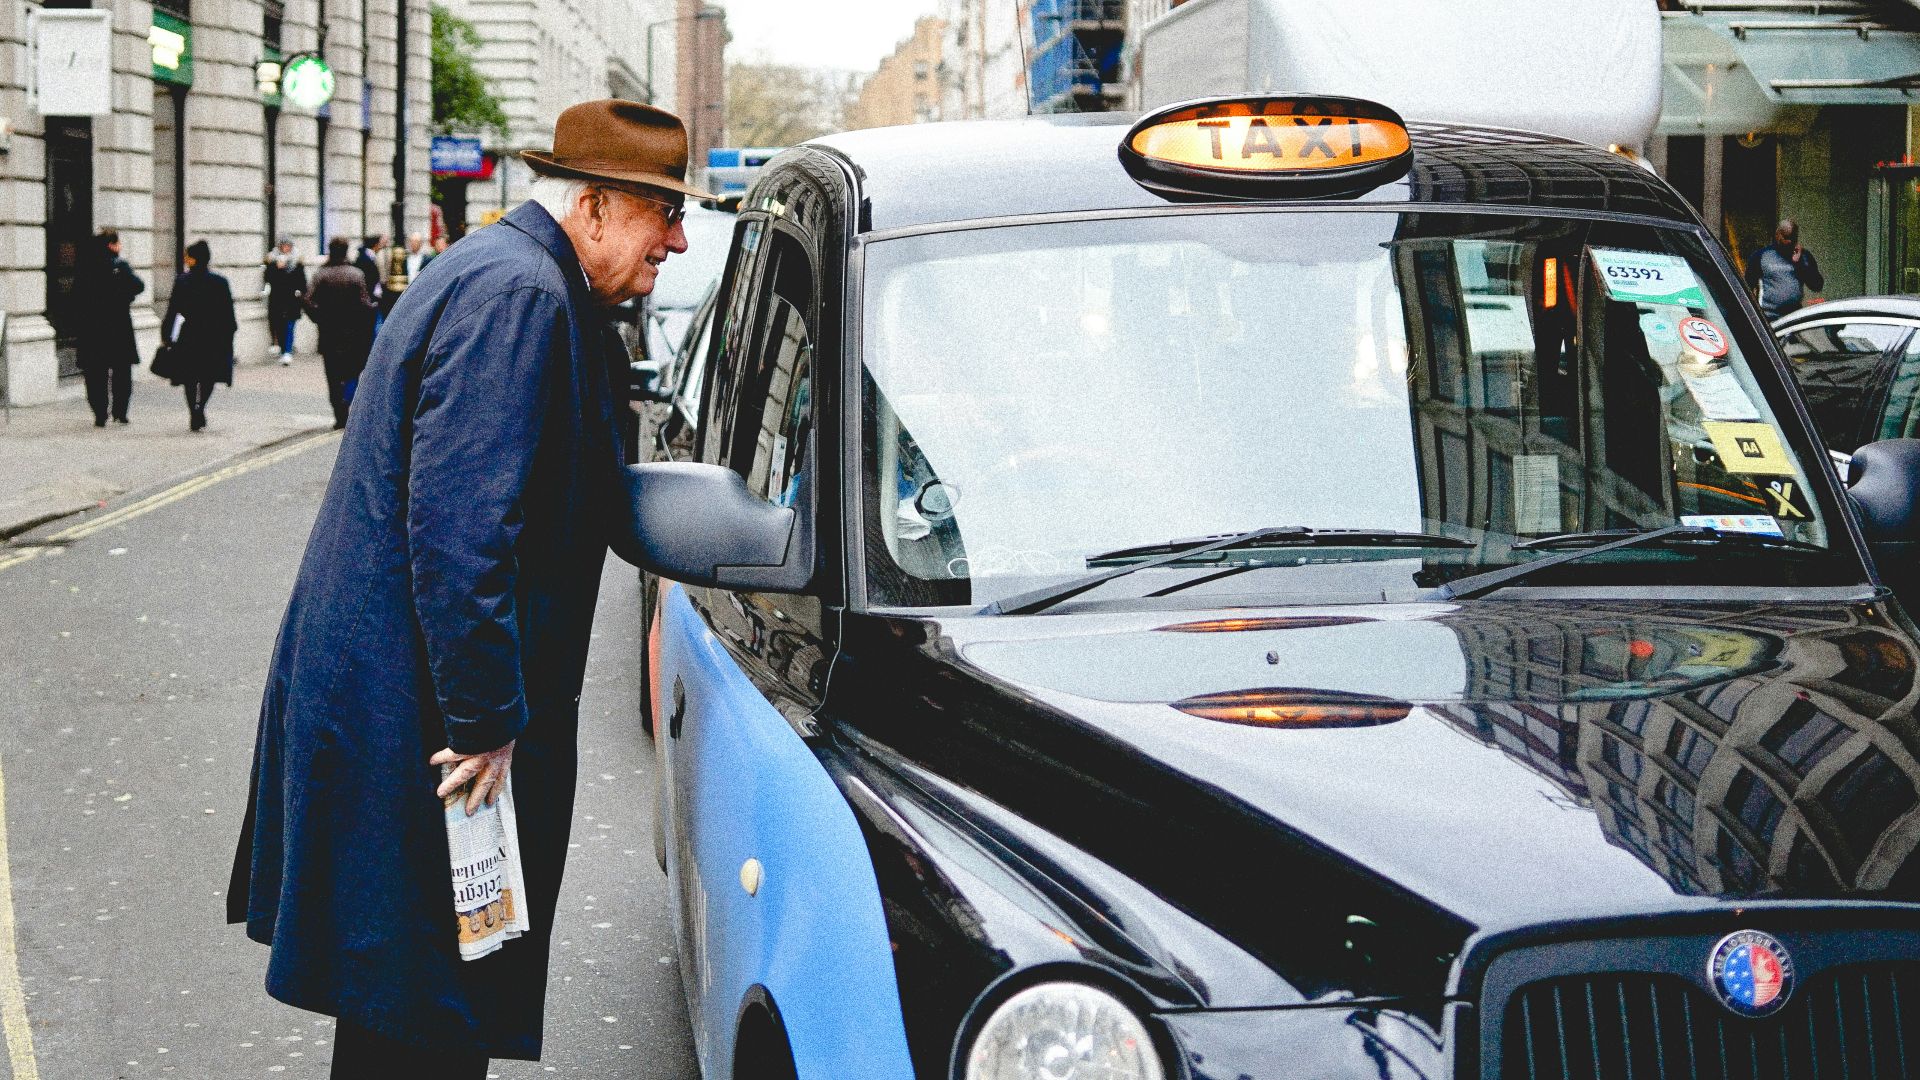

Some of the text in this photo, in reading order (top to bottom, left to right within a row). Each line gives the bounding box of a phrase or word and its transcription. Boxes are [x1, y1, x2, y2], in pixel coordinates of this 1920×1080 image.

[1197, 118, 1362, 160] TAXI
[1607, 266, 1664, 281] 63392
[1742, 441, 1759, 453] AA
[1723, 935, 1772, 953] LONDON
